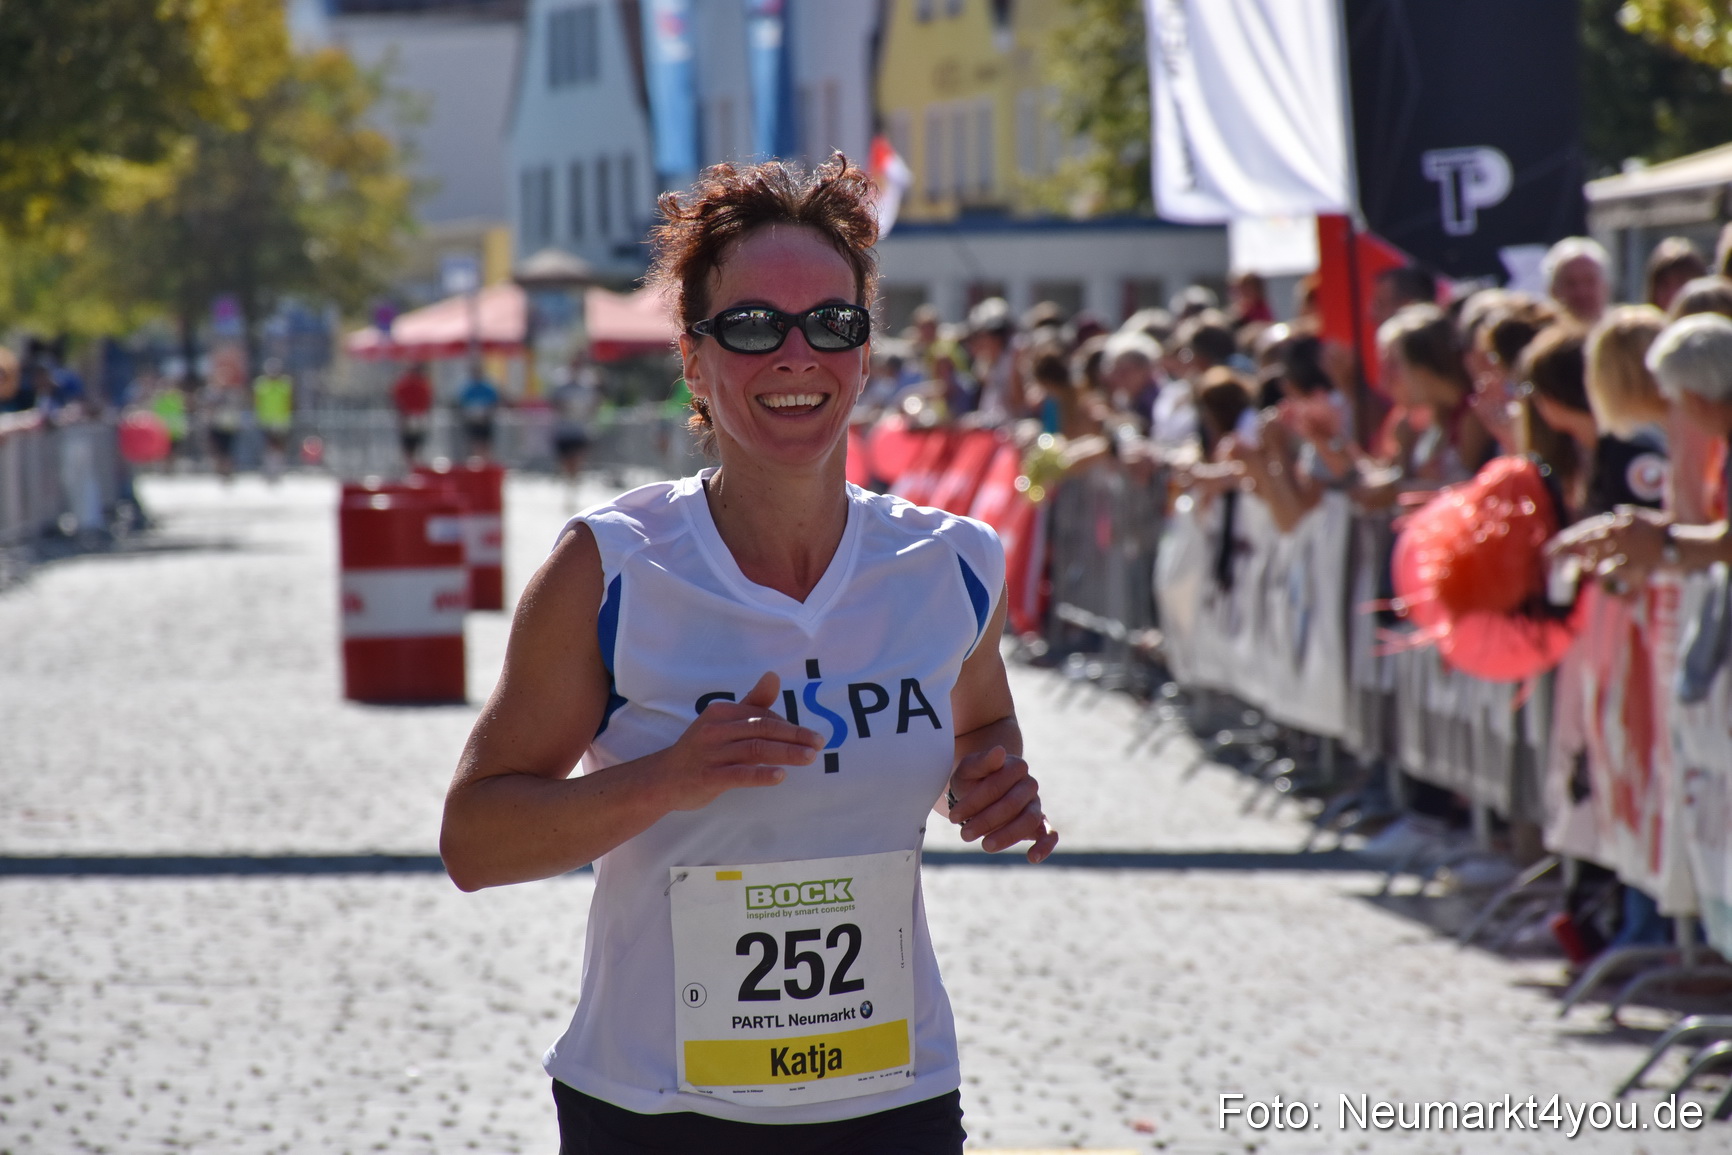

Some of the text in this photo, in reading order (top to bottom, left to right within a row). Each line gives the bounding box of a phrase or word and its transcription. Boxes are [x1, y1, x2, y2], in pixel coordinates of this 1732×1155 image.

[694, 658, 943, 774] SPA
[745, 877, 855, 910] BOCK
[746, 903, 856, 920] inspired by smart concepts
[735, 923, 865, 1002] 252
[690, 989, 699, 1002] D
[732, 1007, 856, 1029] PARTL Neumarkt
[770, 1042, 843, 1079] Katja
